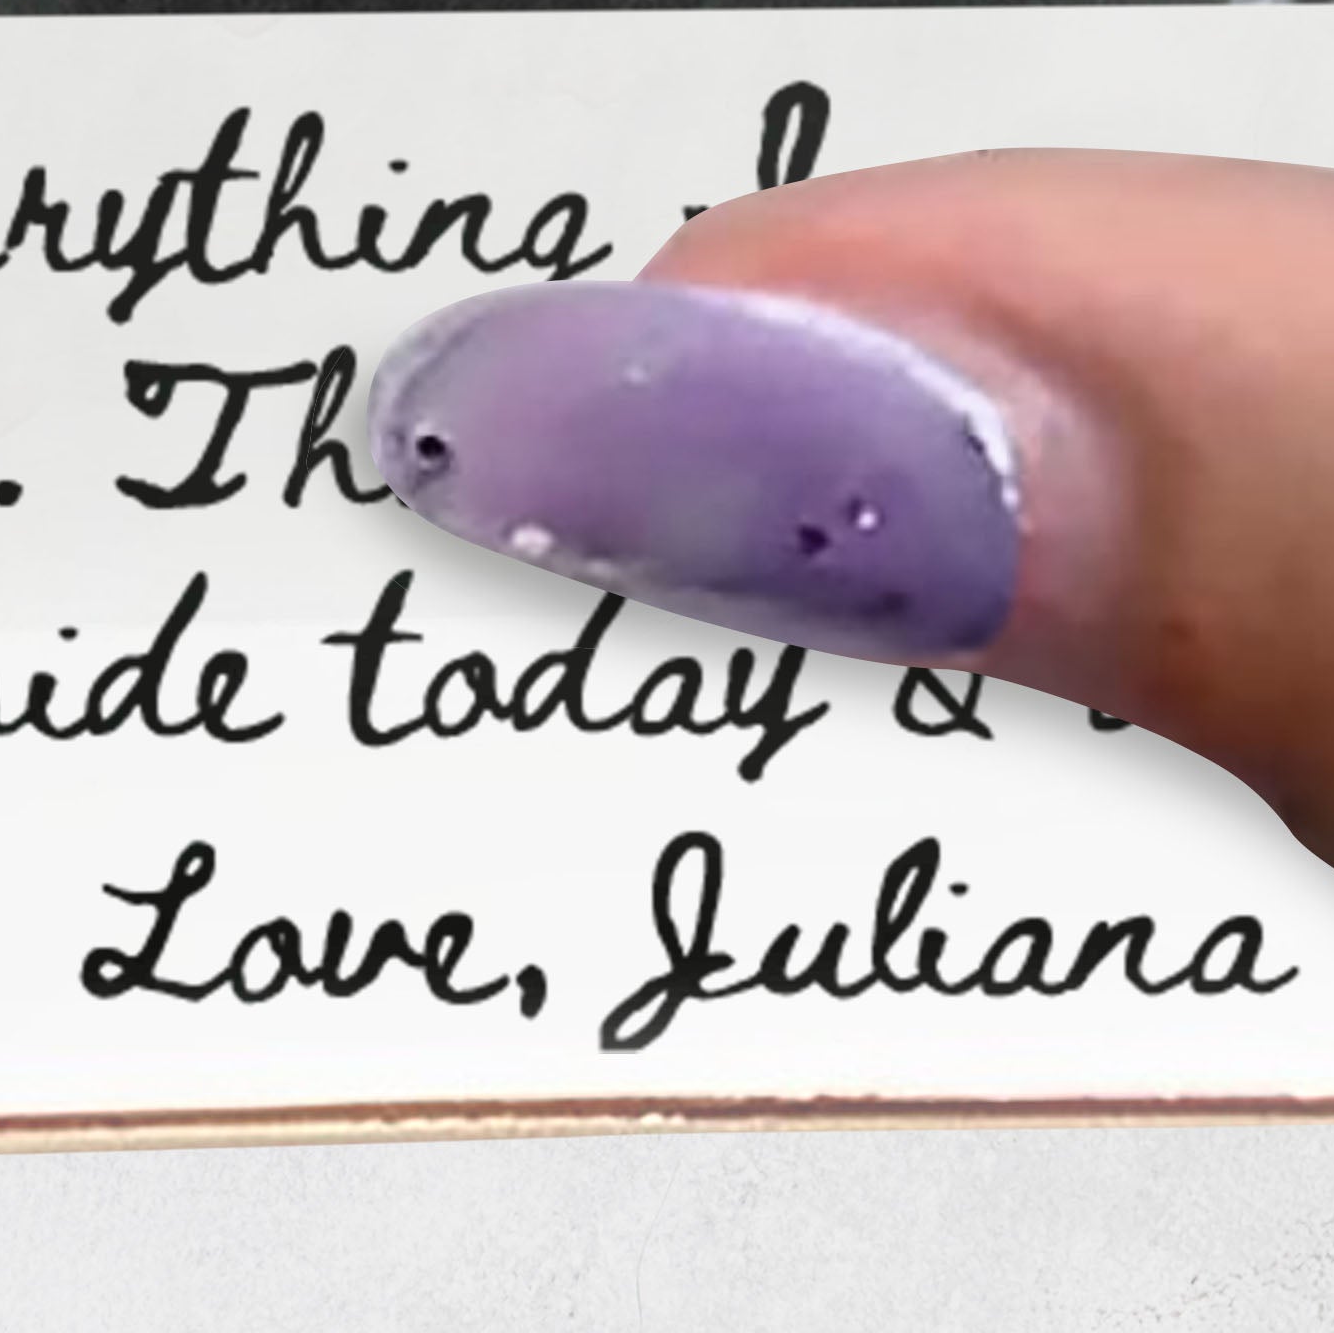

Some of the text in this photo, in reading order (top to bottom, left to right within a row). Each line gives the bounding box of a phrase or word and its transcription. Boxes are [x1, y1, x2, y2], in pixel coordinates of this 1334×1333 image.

[320, 568, 831, 784] today
[79, 829, 1300, 1053] Love, Juliana
